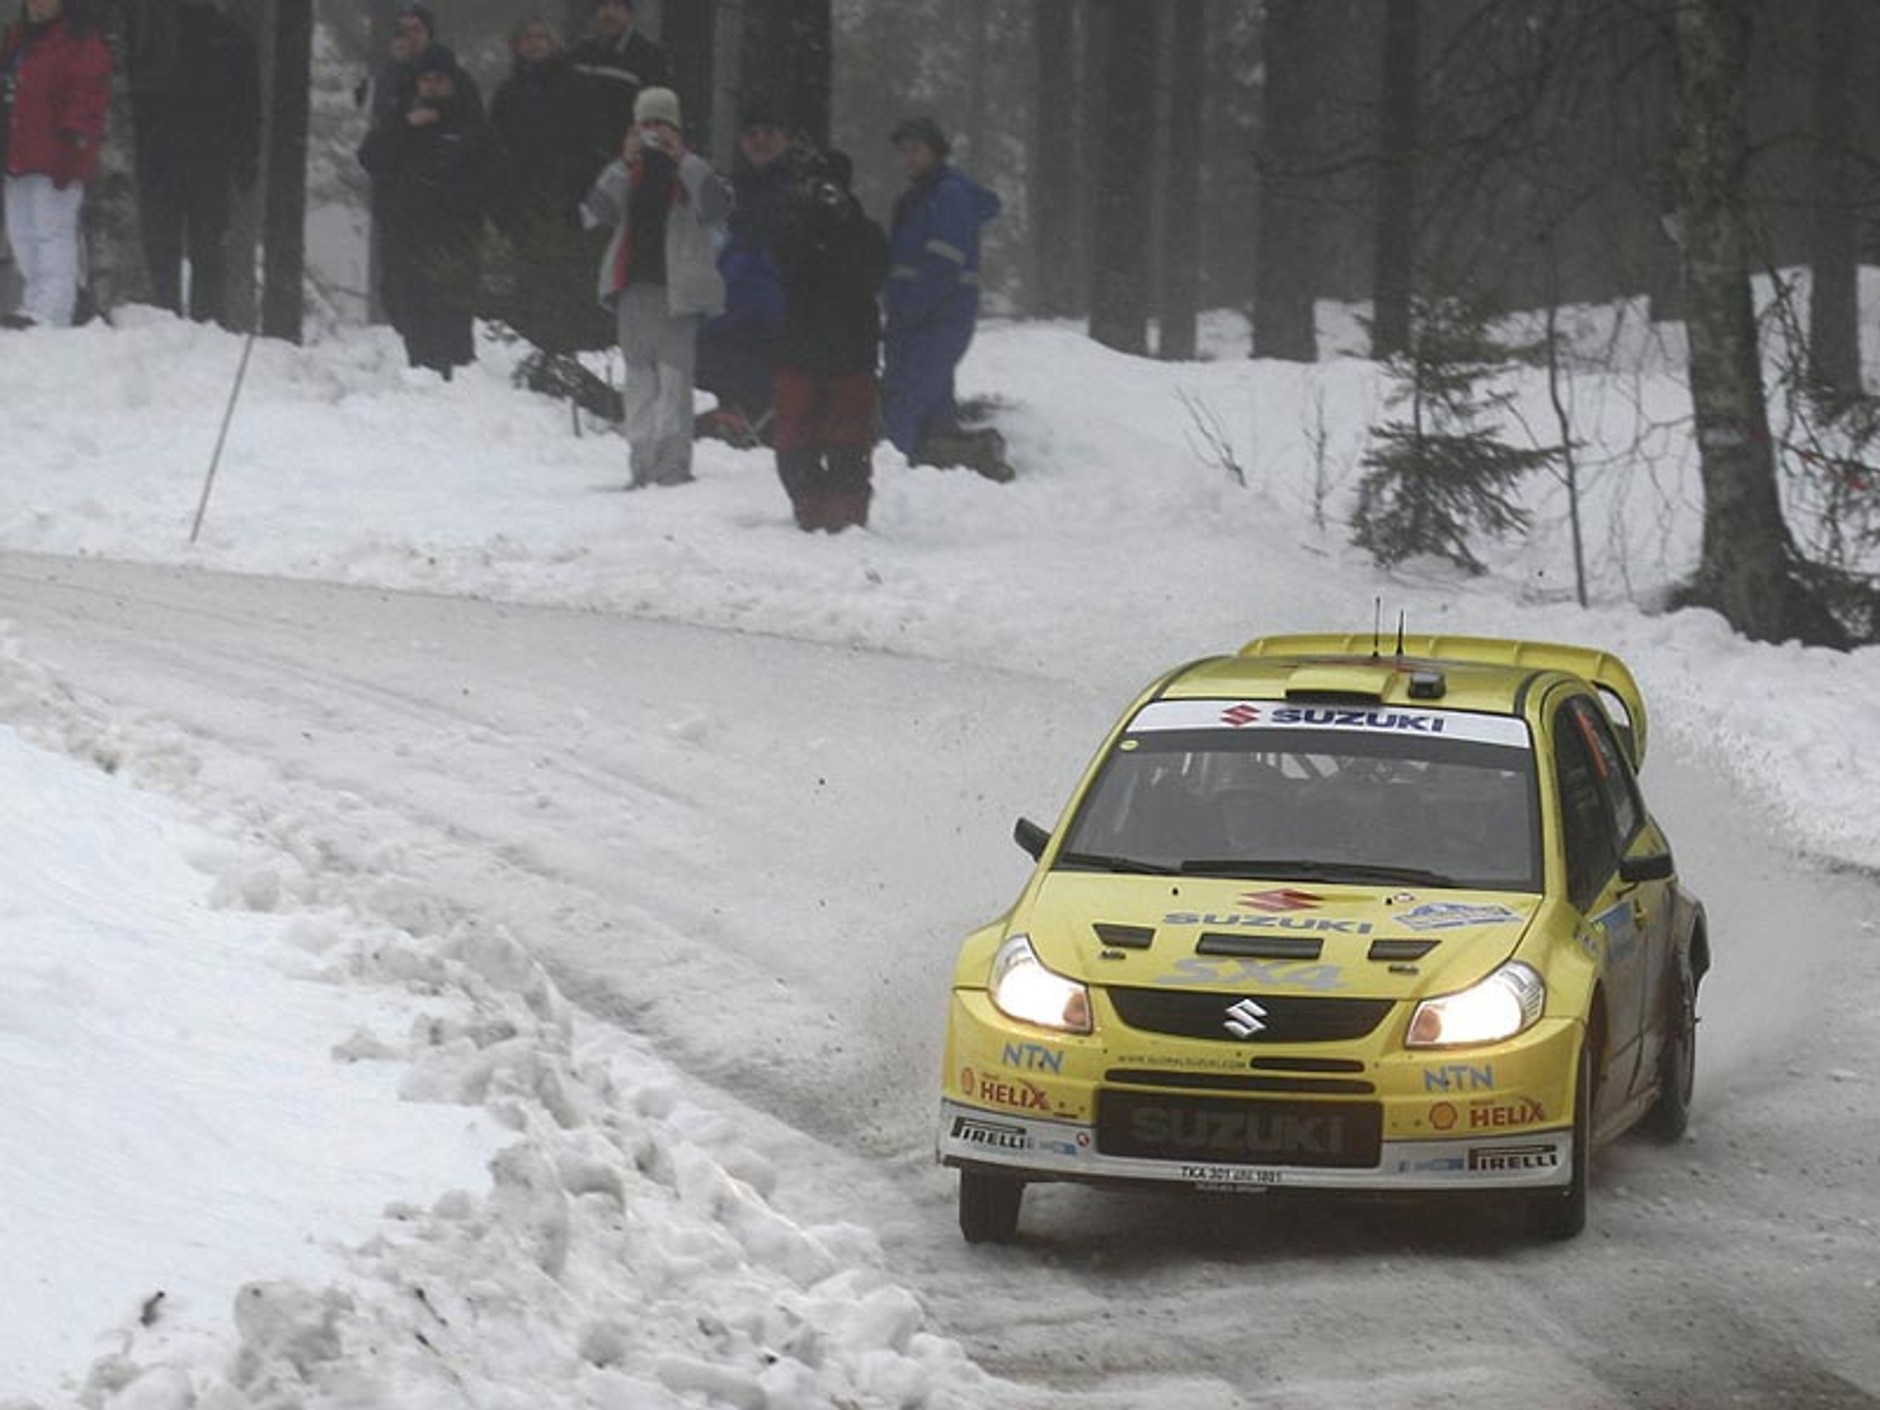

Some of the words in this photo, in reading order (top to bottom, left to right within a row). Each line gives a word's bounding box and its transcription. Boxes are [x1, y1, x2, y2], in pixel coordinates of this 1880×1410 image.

[1271, 709, 1444, 732] SUZUKI
[1163, 913, 1373, 934] SUZUKI
[1155, 956, 1350, 989] SX4
[1003, 1042, 1063, 1073] NTN
[1424, 1065, 1493, 1091] NTN
[980, 1078, 1049, 1110] HELIX
[1470, 1097, 1546, 1128] HELIX
[951, 1116, 1026, 1149] PIRELLI
[1131, 1105, 1344, 1154] SUZUKI
[1468, 1144, 1557, 1171] PIRELLI
